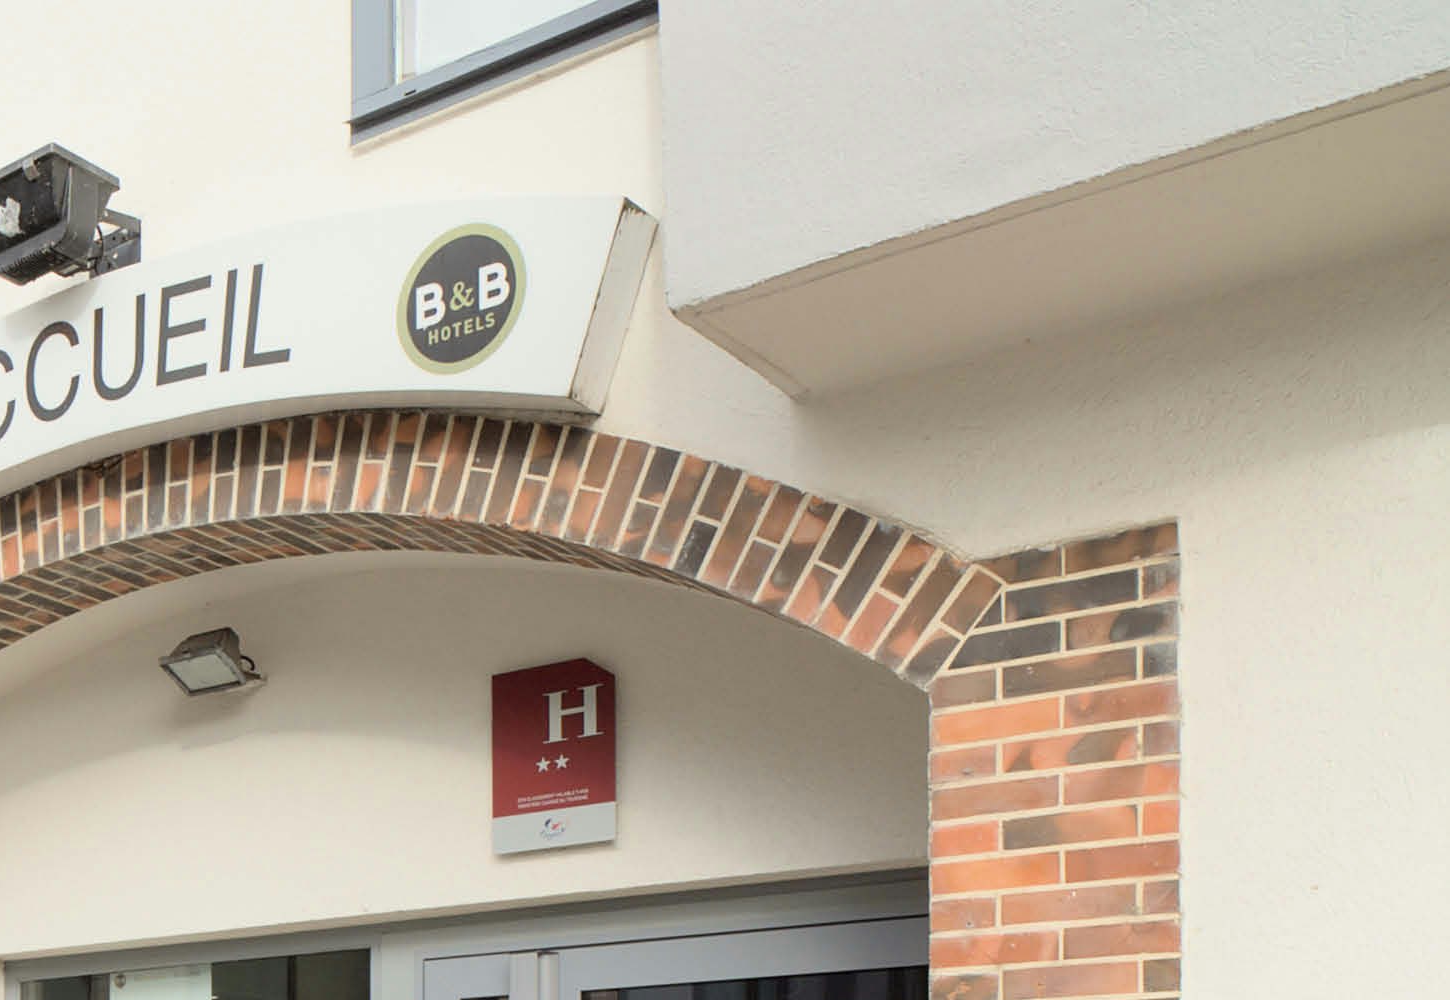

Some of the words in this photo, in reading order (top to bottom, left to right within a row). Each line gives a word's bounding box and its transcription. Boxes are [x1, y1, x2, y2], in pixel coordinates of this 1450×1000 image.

[415, 262, 511, 331] B&B
[427, 311, 496, 346] HOTELS
[542, 683, 605, 744] H
